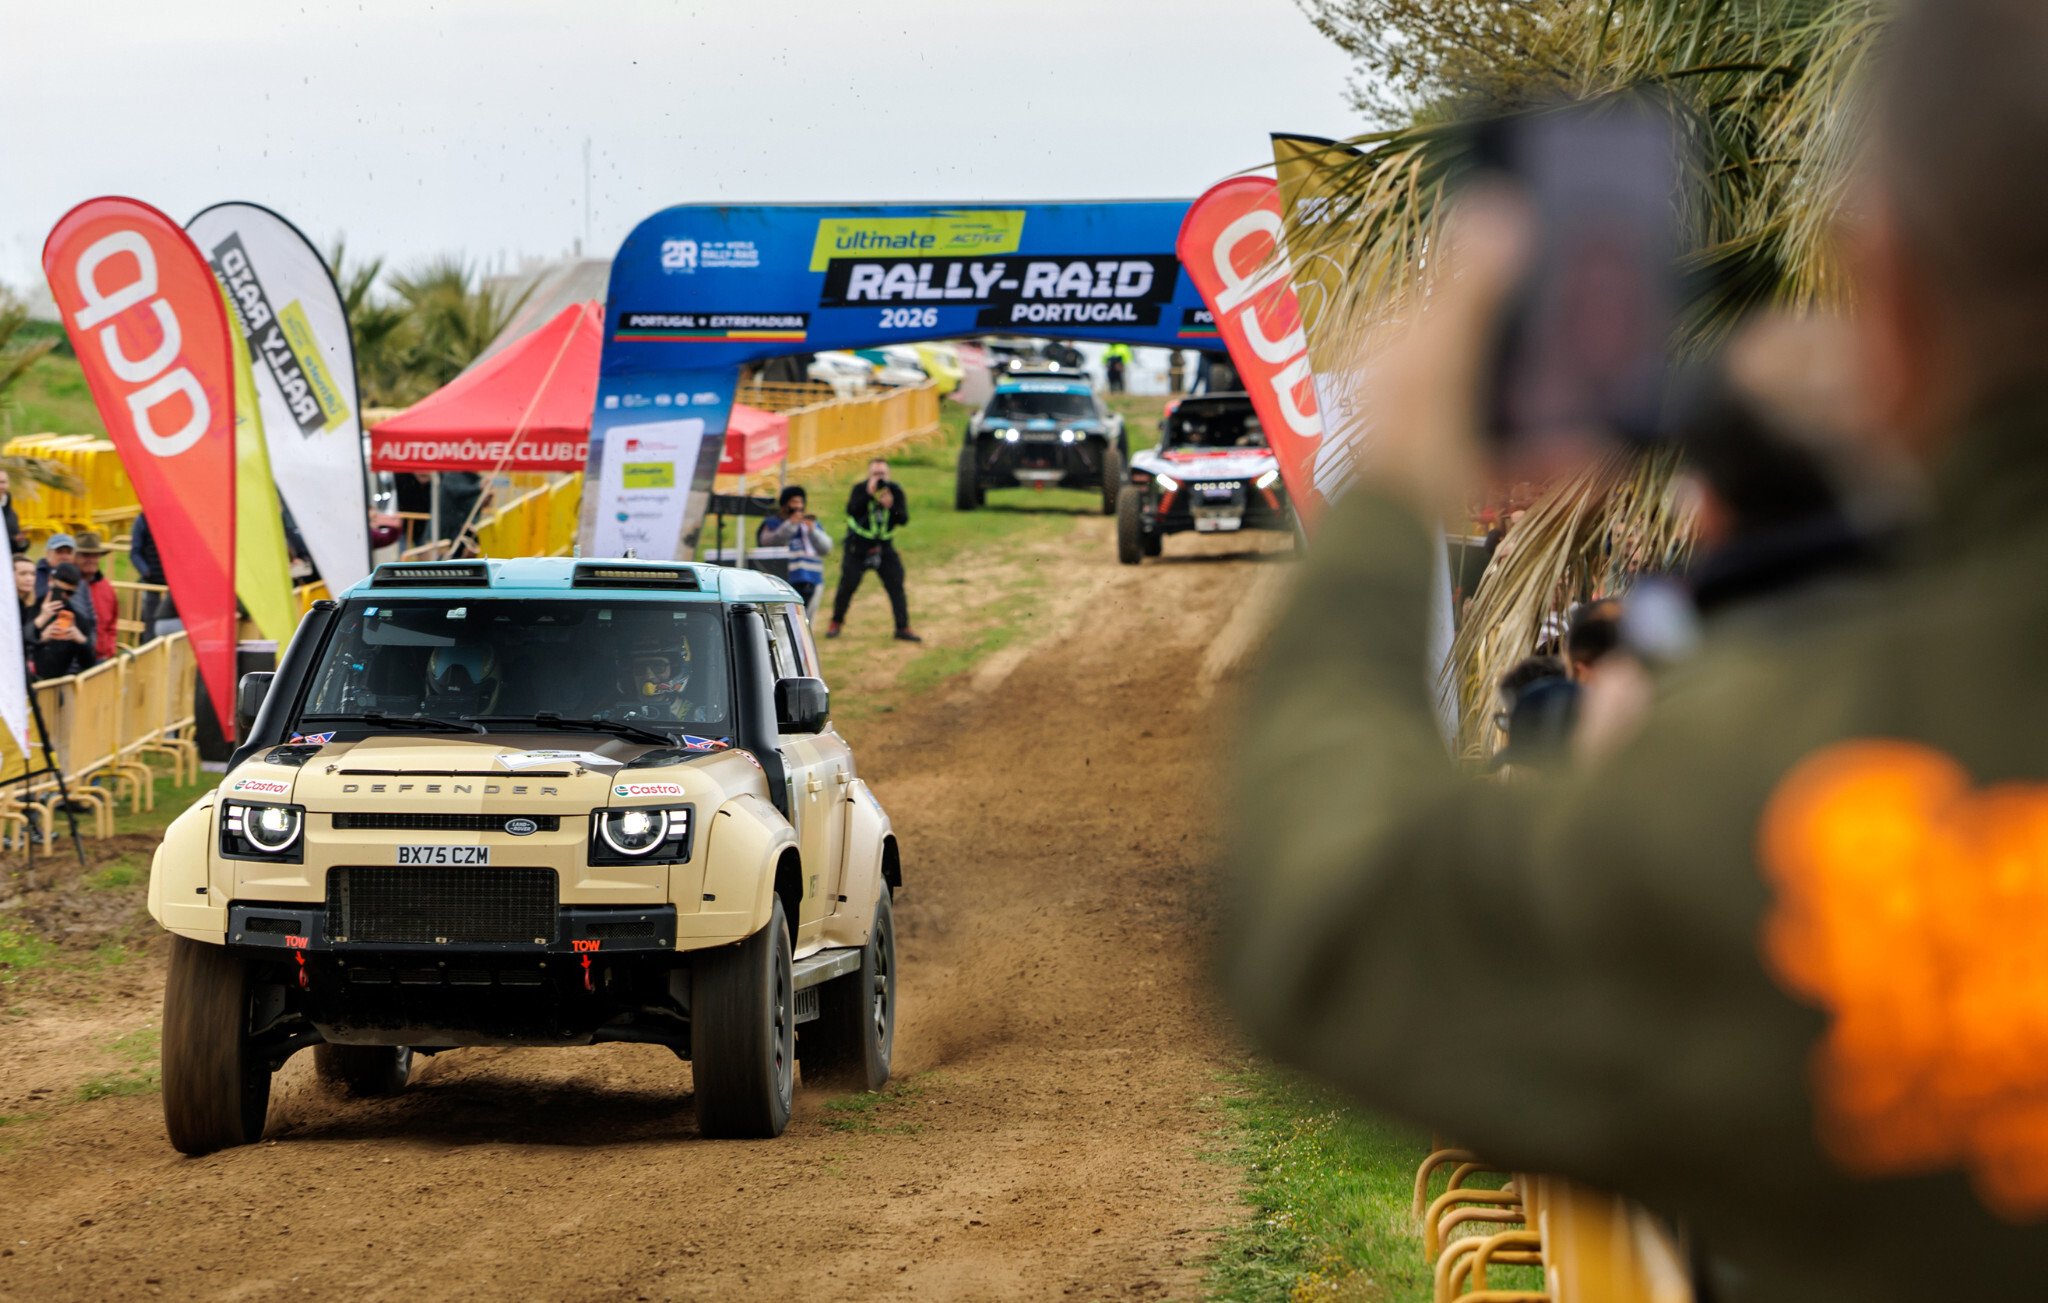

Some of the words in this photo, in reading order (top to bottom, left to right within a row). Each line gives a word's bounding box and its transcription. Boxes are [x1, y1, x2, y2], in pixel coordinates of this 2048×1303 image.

[836, 230, 936, 250] ultimate
[846, 261, 1155, 301] RALLY-RAID
[878, 308, 938, 328] 2026
[1010, 303, 1138, 323] PORTUGAL
[630, 315, 696, 328] PORTUGAL
[708, 315, 804, 328] EXTREMADURA
[378, 438, 514, 461] AUTOMÓVEL
[515, 441, 574, 461] CLUB
[245, 781, 289, 793] Castrol
[342, 784, 558, 797] DEFENDER
[629, 785, 681, 795] Castrol
[399, 847, 447, 864] BX75
[452, 847, 488, 864] CZM
[284, 935, 309, 949] TOW
[571, 939, 601, 953] TOW
